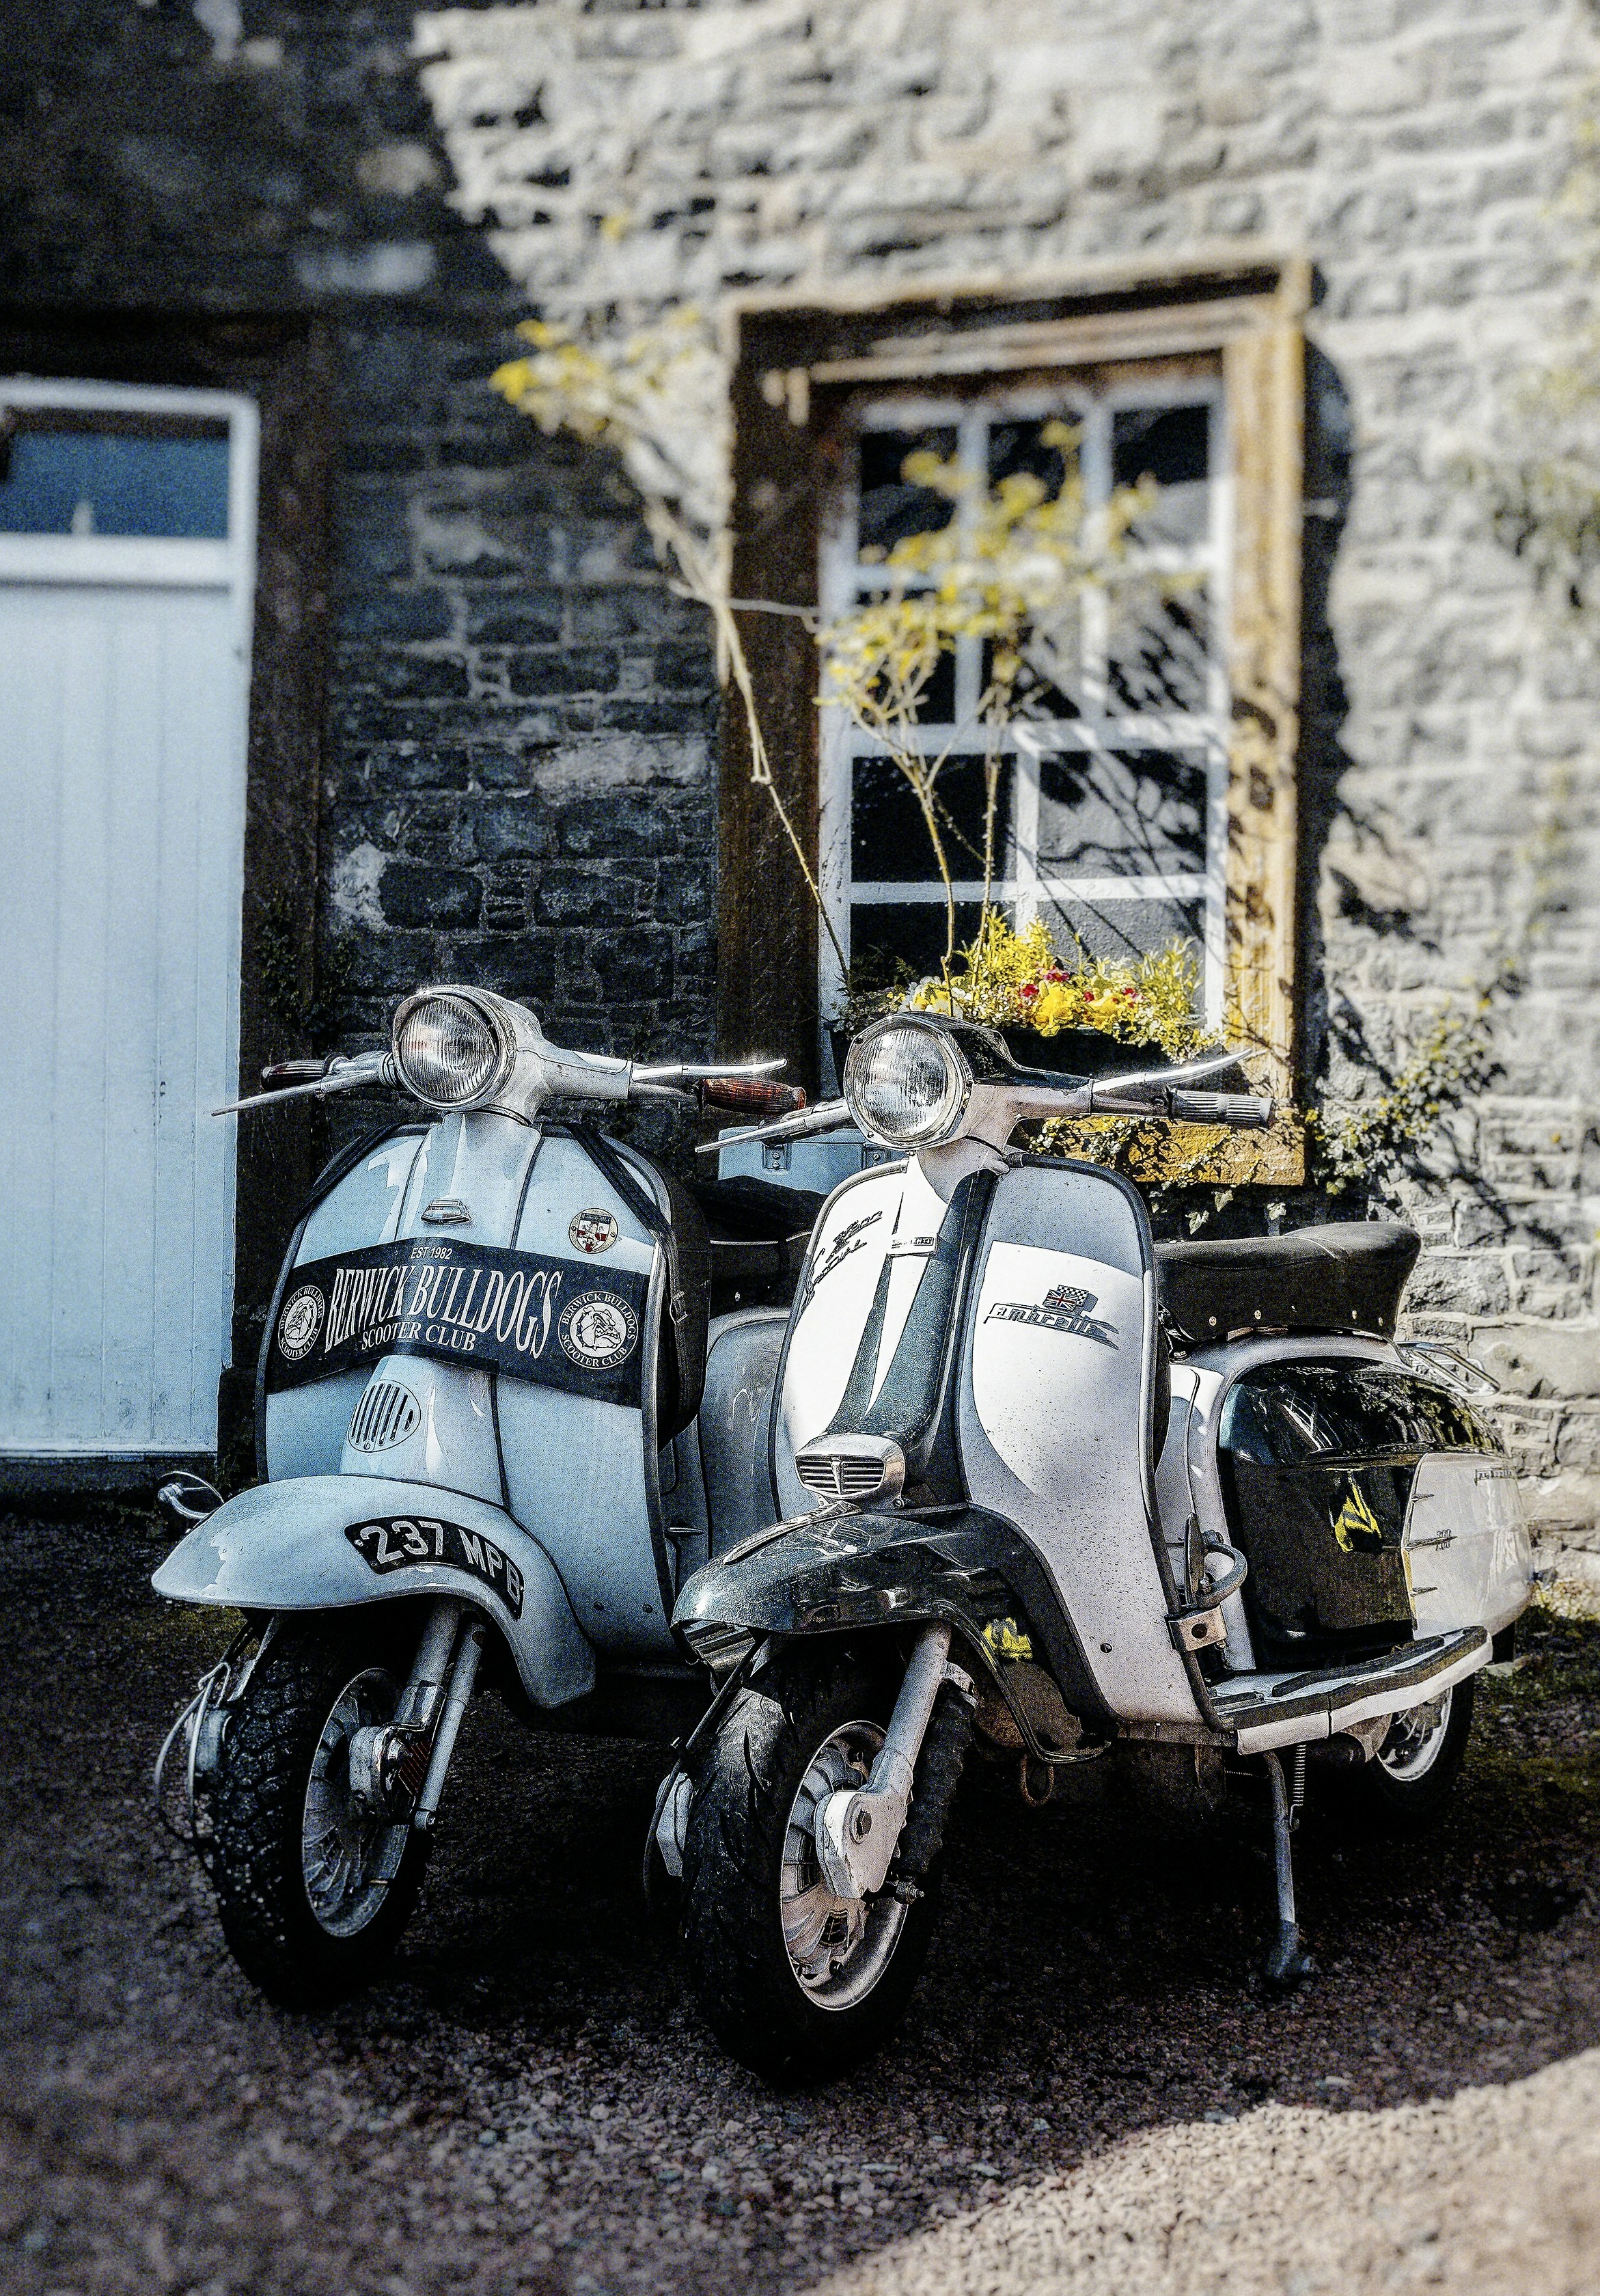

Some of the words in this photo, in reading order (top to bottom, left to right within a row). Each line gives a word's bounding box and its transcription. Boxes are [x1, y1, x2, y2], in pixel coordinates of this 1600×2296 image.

[410, 1246, 430, 1259] EST
[431, 1246, 452, 1260] 1982
[324, 1265, 414, 1354] BERWICK
[409, 1264, 564, 1359] BULLDOGS
[561, 1293, 602, 1325] BERWICK
[603, 1294, 637, 1341] BULLDOGS
[361, 1322, 420, 1351] SCOOTER
[425, 1324, 476, 1352] CLUB
[561, 1333, 600, 1367] SCOOTER
[601, 1346, 628, 1367] CLUB
[359, 1520, 443, 1565] 237
[458, 1528, 521, 1605] MPB
